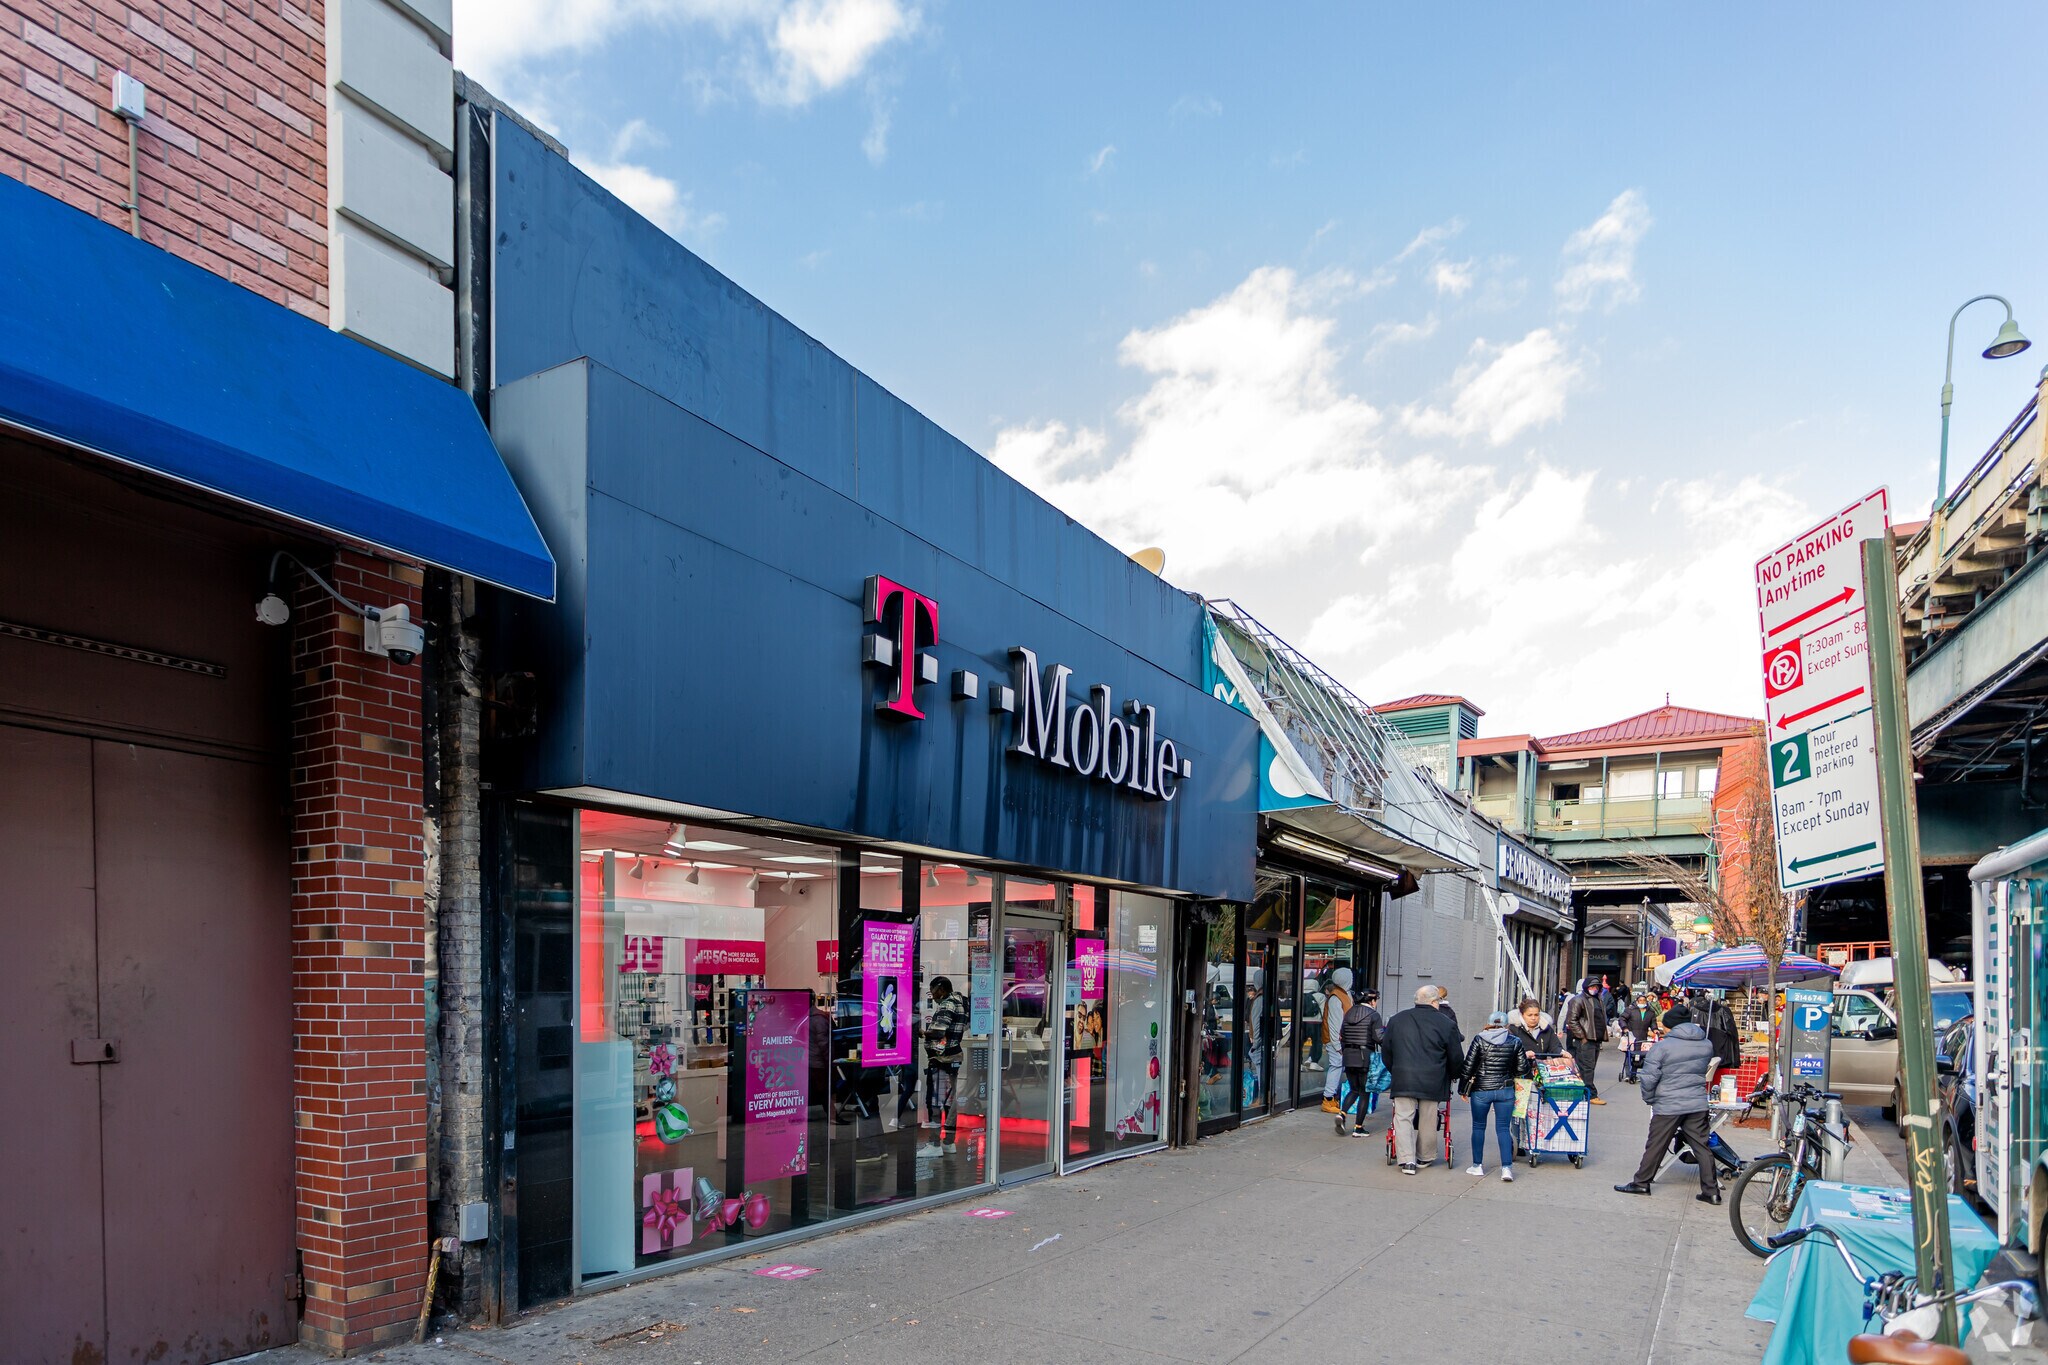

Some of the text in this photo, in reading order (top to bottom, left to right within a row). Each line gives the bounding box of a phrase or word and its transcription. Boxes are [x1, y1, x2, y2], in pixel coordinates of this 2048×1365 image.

[1762, 519, 1853, 585] NO PARKING
[1766, 564, 1825, 607] Anytime
[1806, 632, 1844, 655] 7:30am
[1854, 621, 1867, 634] 8a
[1807, 650, 1841, 675] Except
[1813, 730, 1836, 747] hour
[1815, 735, 1858, 761] metered
[1780, 742, 1801, 782] 2
[1816, 754, 1854, 778] parking
[1781, 801, 1805, 817] 8am
[1817, 789, 1842, 807] 7pm
[1783, 800, 1870, 836] Except Sunday
[713, 950, 727, 964] 5G
[871, 942, 905, 962] FREE
[1080, 954, 1099, 967] PRICE
[1083, 967, 1096, 979] YOU
[1083, 979, 1095, 991] SEE
[1795, 994, 1822, 1002] 214674
[762, 1036, 793, 1046] FAMILIES
[749, 1047, 805, 1065] GET OVER
[758, 1065, 796, 1088] $225
[748, 1096, 804, 1111] EVERY MONTH
[753, 1092, 771, 1100] WORTH
